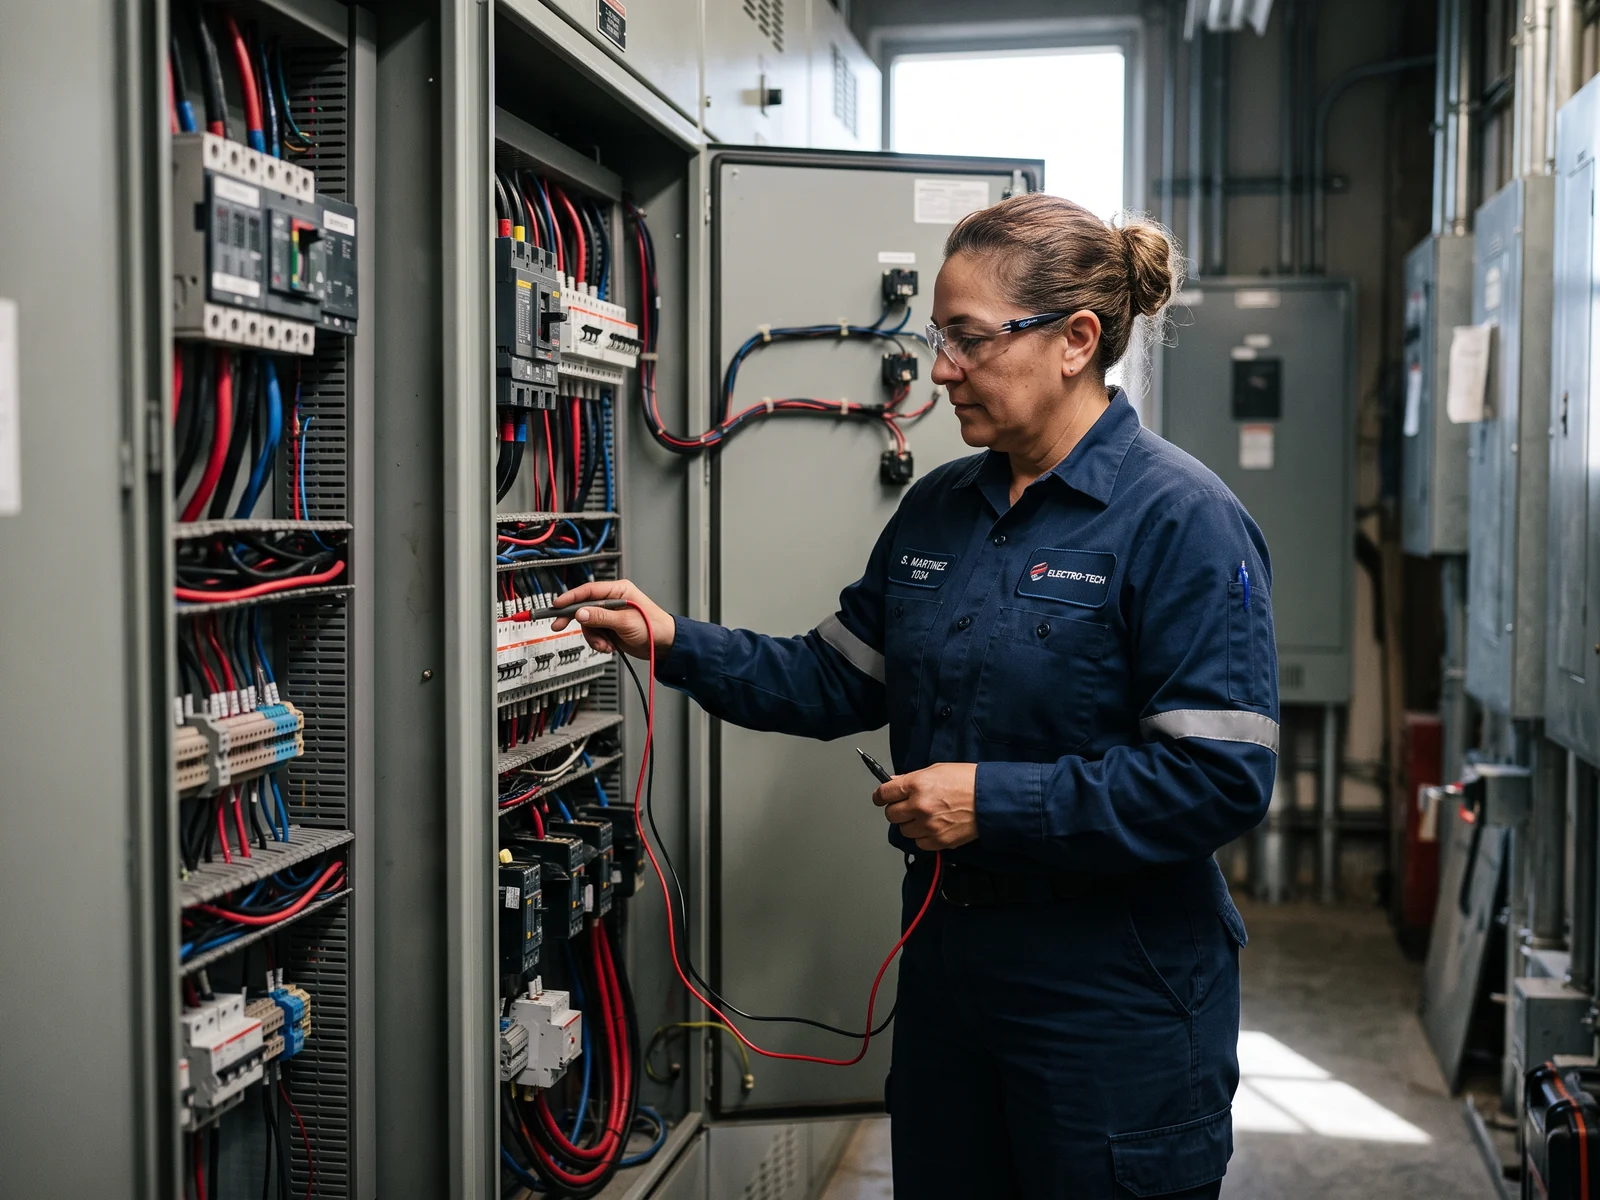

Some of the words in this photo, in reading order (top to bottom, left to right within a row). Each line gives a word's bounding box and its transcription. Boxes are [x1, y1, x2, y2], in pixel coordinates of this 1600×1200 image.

[901, 555, 908, 565] S.
[910, 557, 948, 571] MARTINEZ
[911, 569, 930, 580] 1034
[1047, 569, 1107, 584] ELECTRO-TECH
